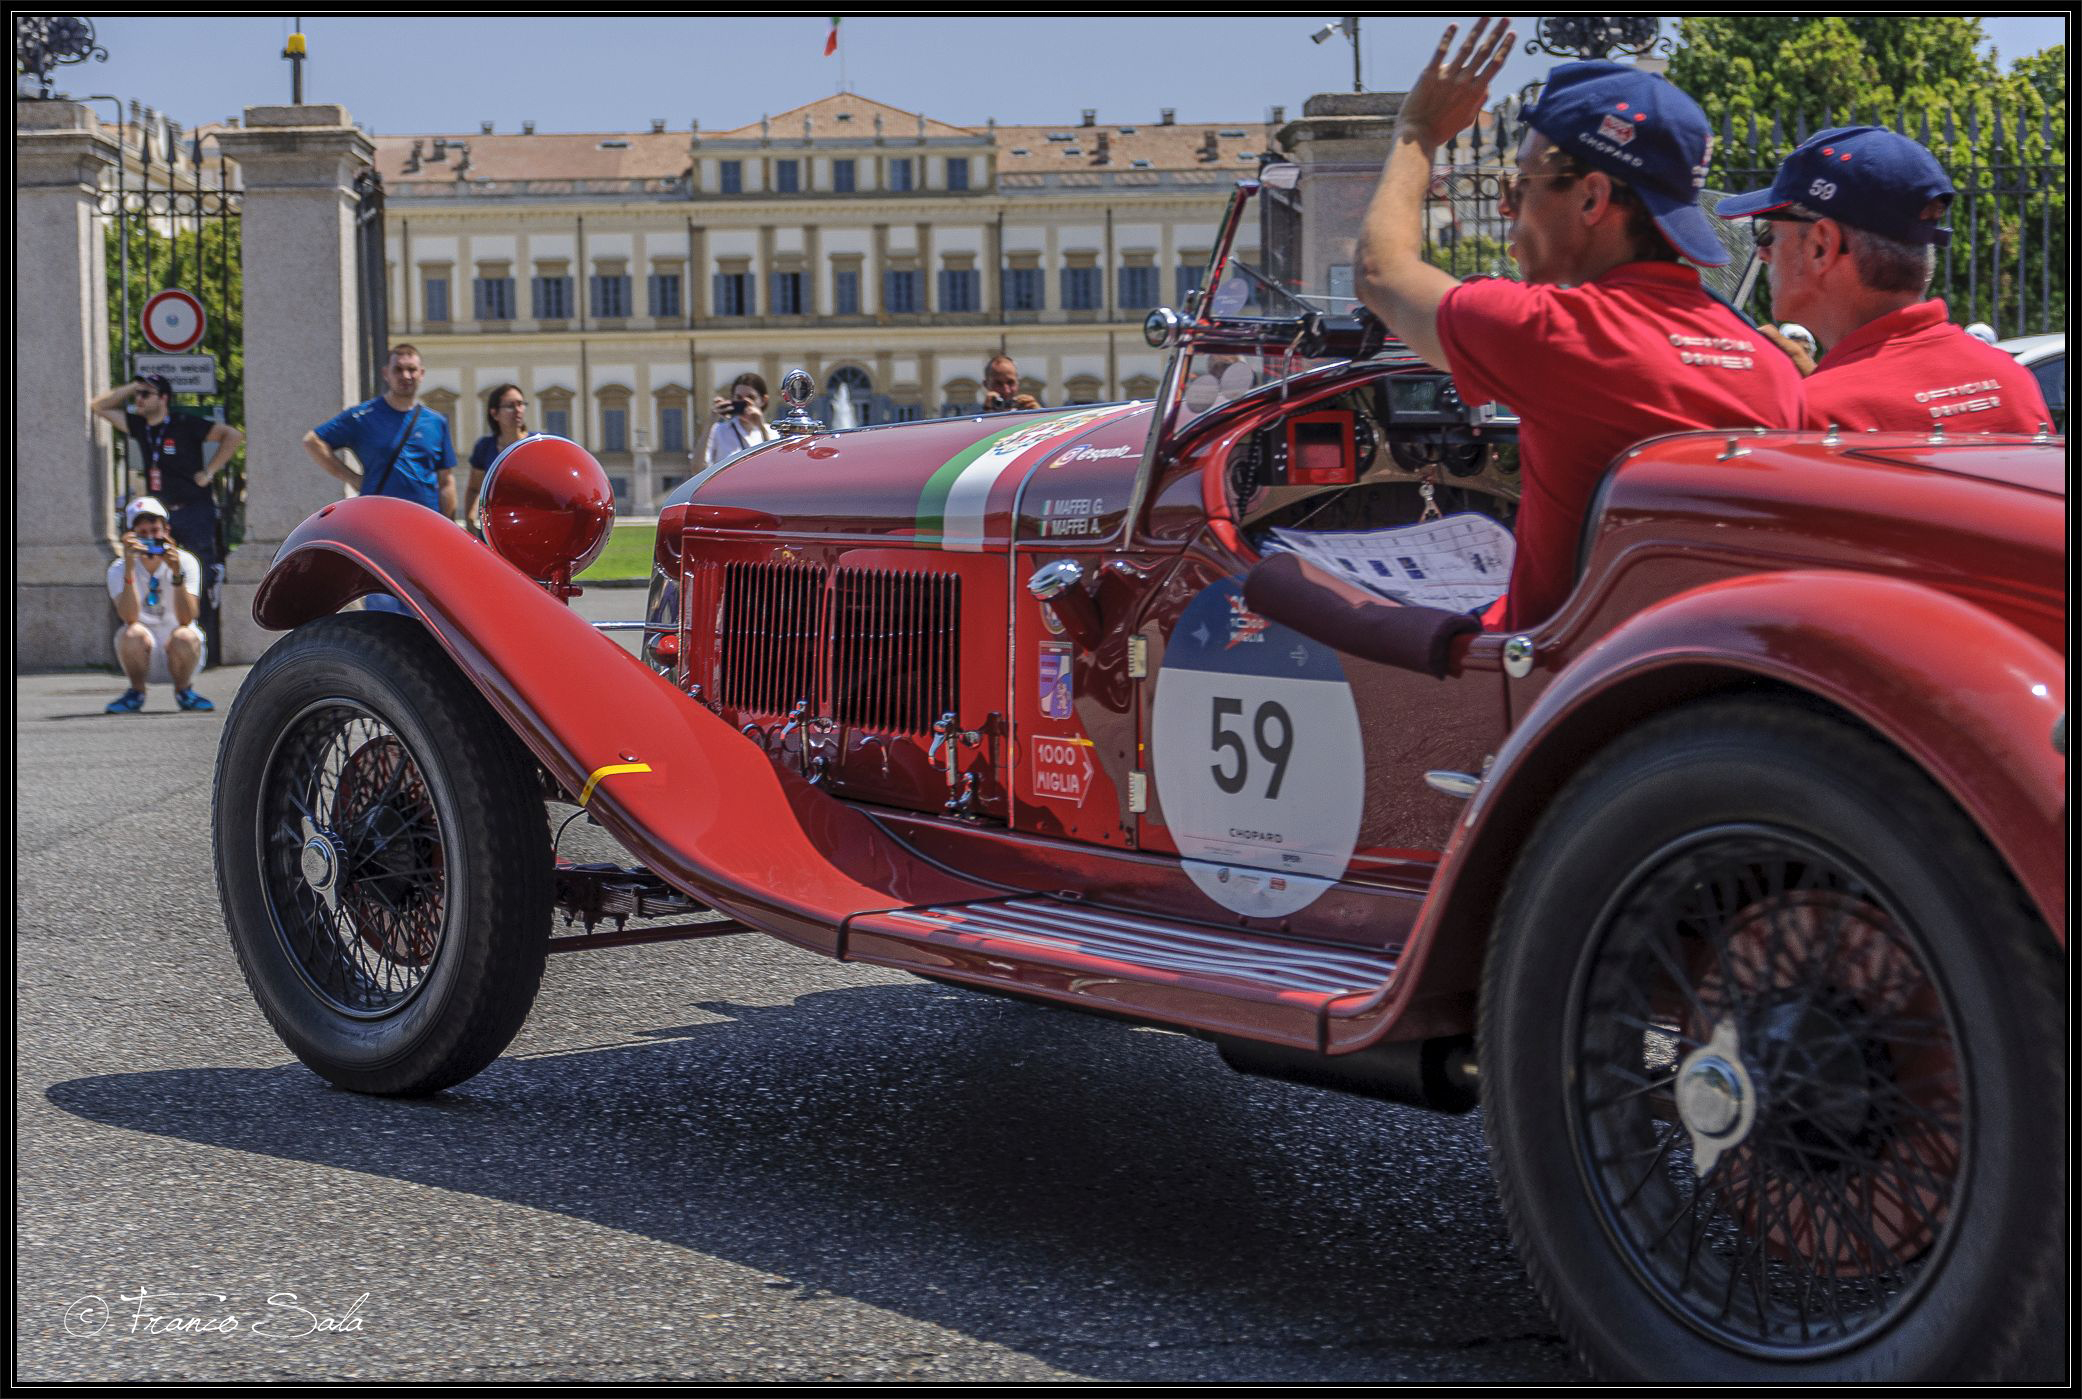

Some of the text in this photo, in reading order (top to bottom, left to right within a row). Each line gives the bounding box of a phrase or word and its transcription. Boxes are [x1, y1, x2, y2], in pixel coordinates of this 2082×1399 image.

[1578, 132, 1644, 168] CHOPARD
[1808, 178, 1838, 200] 59
[1668, 333, 1757, 352] OFFICIAL
[1680, 351, 1754, 369] DRIVER
[1914, 379, 2002, 403] OFFICIAL
[1928, 396, 2001, 418] DRIVER
[1054, 499, 1091, 515] MAFFEI
[1051, 519, 1088, 535] MAFFEI
[1037, 744, 1076, 766] 1000
[1211, 696, 1294, 800] 59
[1036, 773, 1080, 793] MIGLIA
[1229, 827, 1284, 844] CHOPARD
